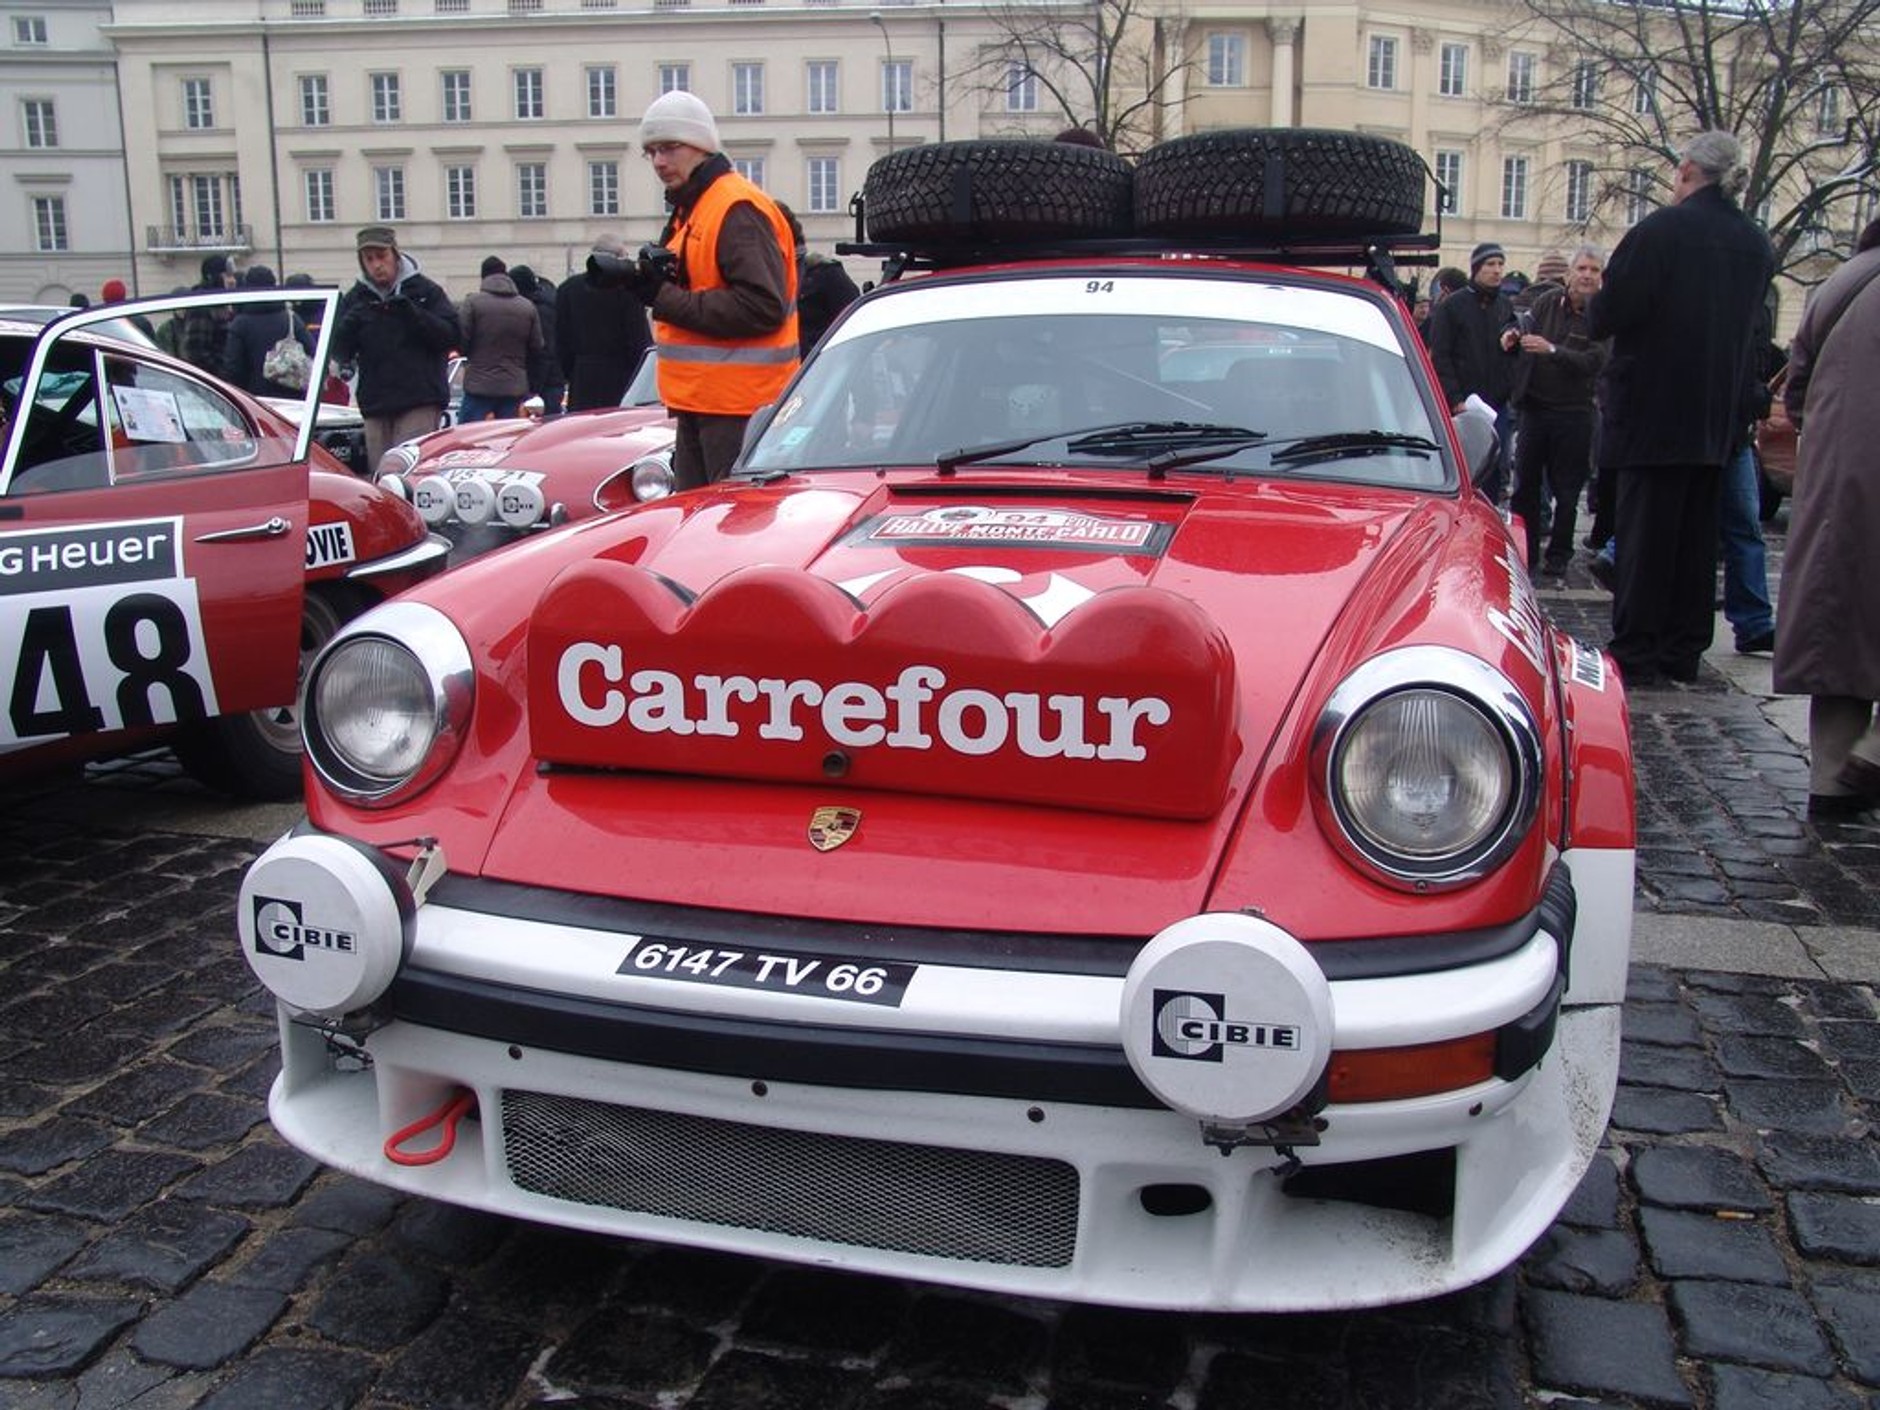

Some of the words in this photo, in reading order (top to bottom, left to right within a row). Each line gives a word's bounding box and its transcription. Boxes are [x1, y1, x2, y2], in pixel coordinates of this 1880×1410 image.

[1086, 280, 1114, 293] 94
[9, 593, 208, 738] 48
[557, 641, 1171, 763] Carrefour
[273, 924, 352, 951] CIBIE
[634, 943, 742, 977] 6147
[755, 954, 820, 986] TV
[826, 964, 888, 995] 66
[1181, 1021, 1294, 1047] CIBIE
